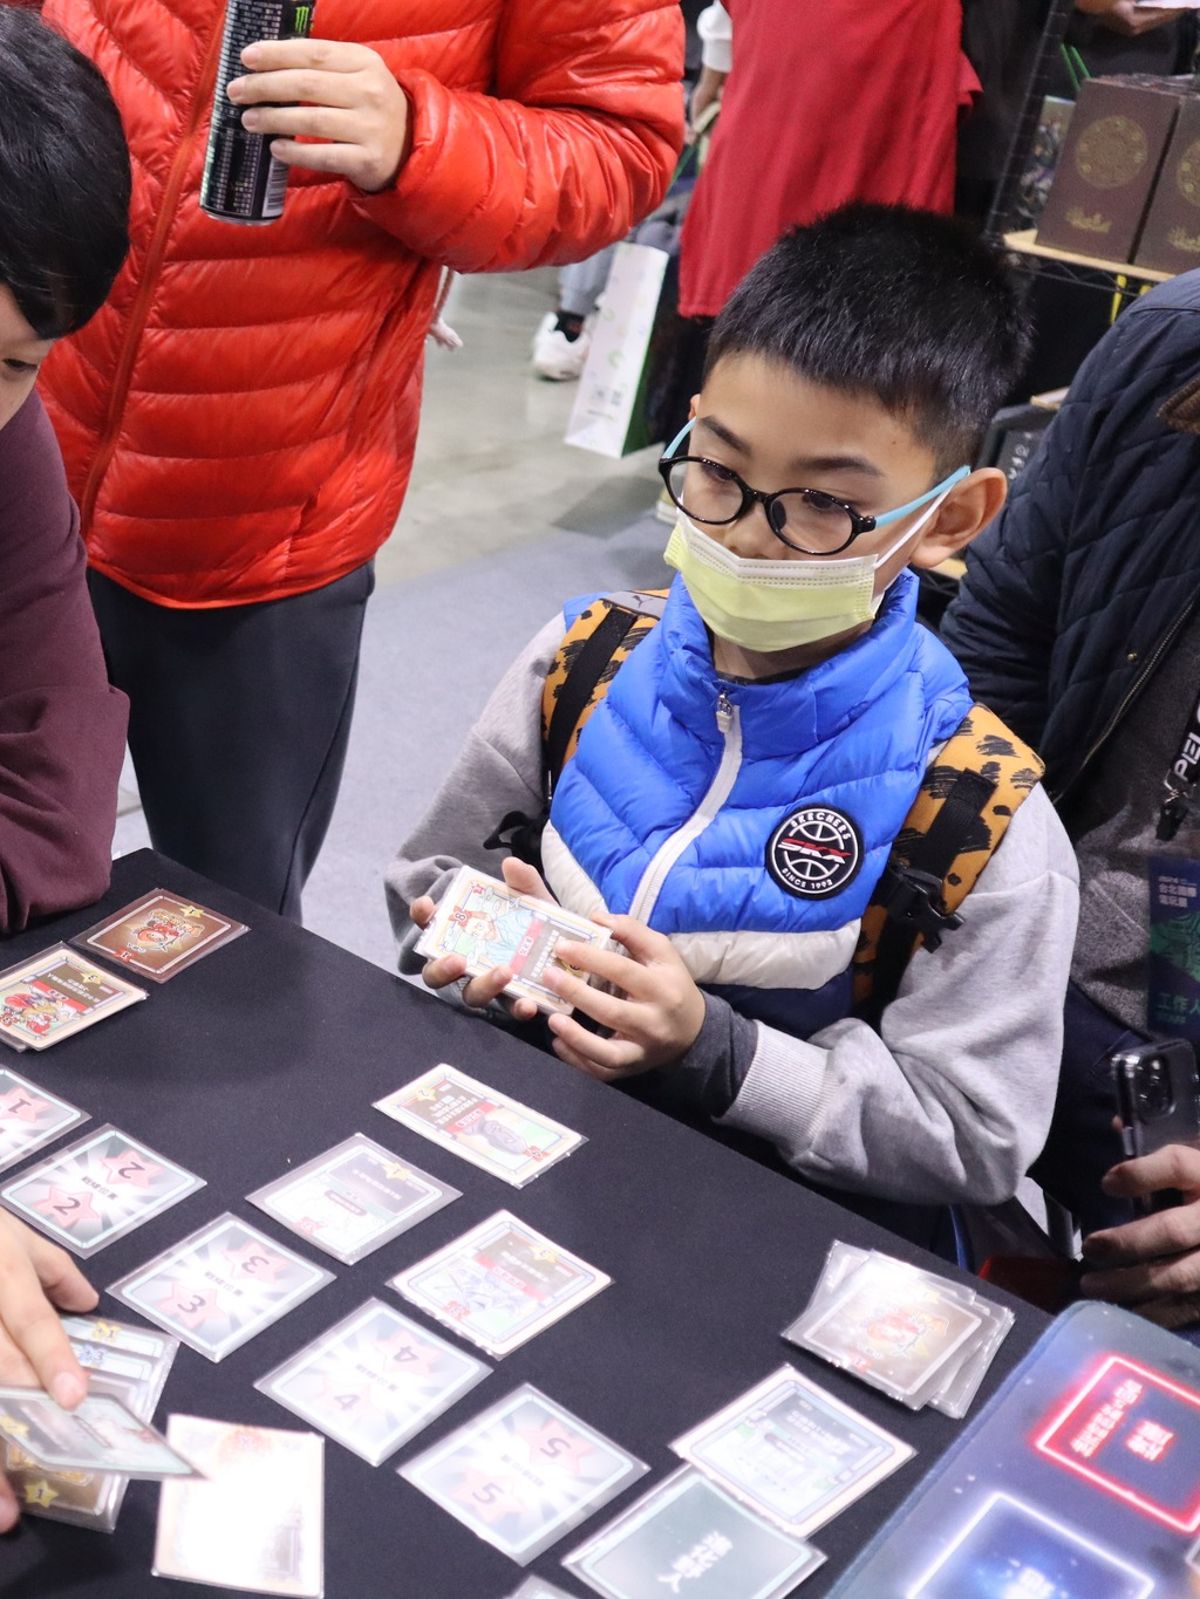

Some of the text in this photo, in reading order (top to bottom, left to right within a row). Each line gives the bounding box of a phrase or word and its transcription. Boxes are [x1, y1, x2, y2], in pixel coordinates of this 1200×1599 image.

[790, 812, 851, 840] SKECHERS
[782, 867, 833, 889] SINCE 1992
[7, 1098, 31, 1113] 1
[118, 1161, 144, 1178] 2
[52, 1197, 80, 1215] 2
[241, 1255, 269, 1273] 3
[177, 1294, 205, 1313] 3
[393, 1345, 418, 1362] 4
[334, 1394, 360, 1410] 4
[539, 1437, 570, 1457] 5
[471, 1482, 502, 1504] 5
